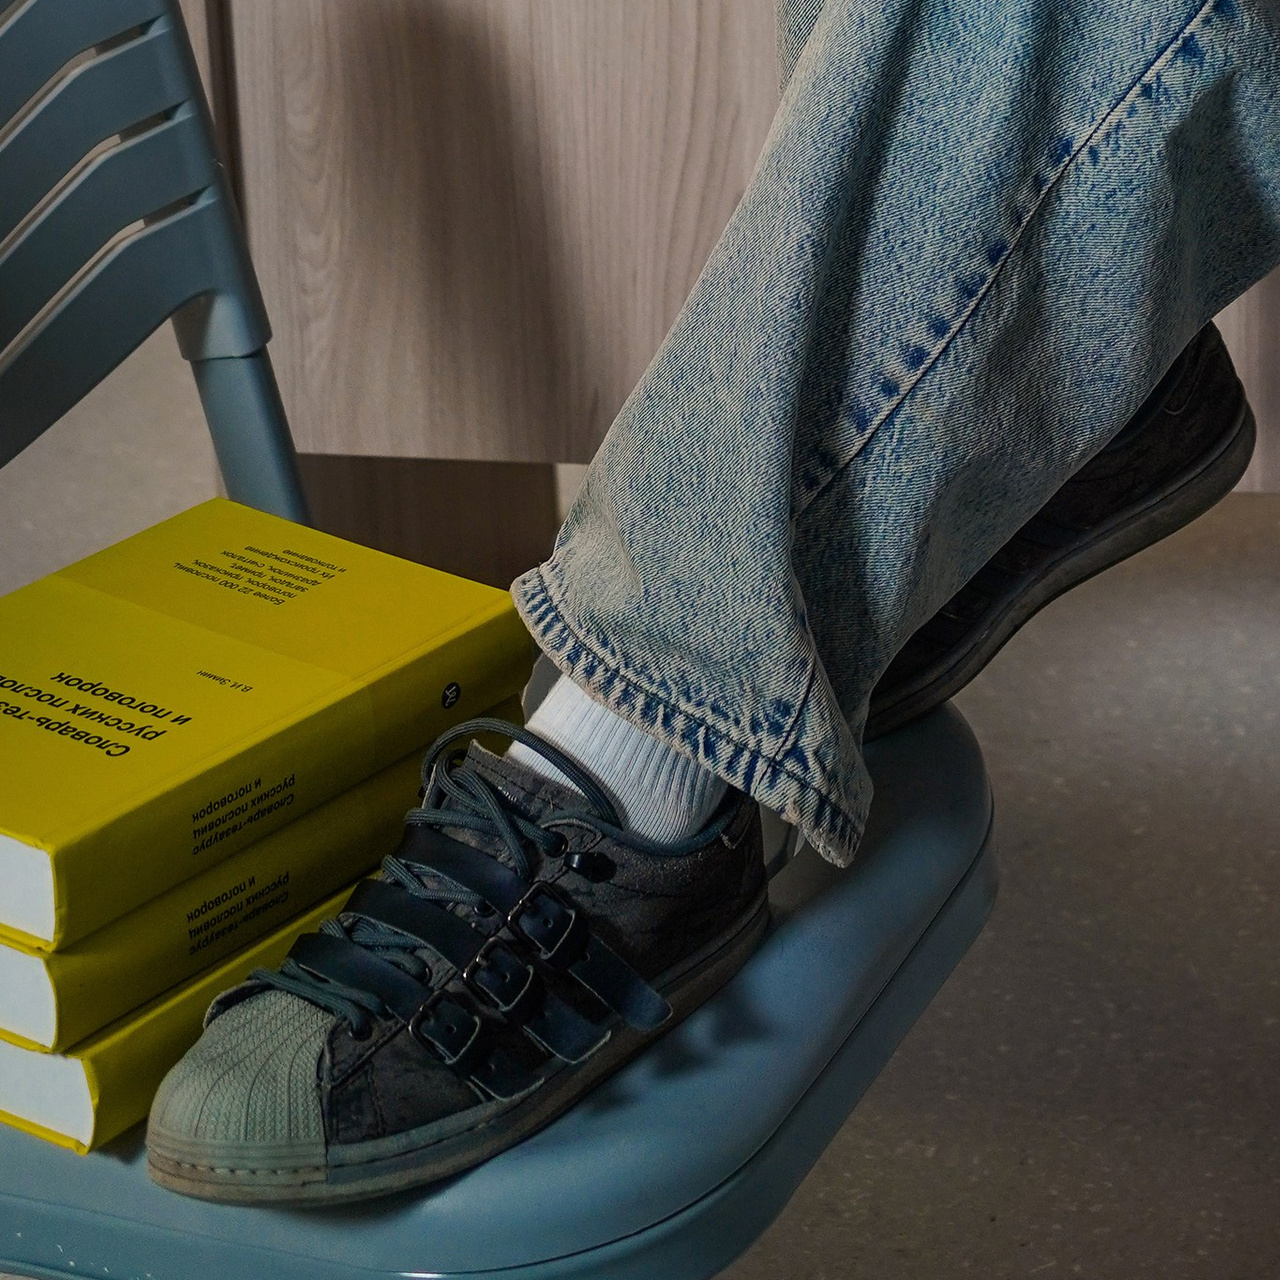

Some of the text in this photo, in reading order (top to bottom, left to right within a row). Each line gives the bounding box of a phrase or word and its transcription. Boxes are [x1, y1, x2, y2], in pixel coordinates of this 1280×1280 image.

[253, 592, 285, 605] Более
[50, 672, 192, 726] и поговорок
[66, 704, 167, 741] русских
[191, 776, 261, 823] и поговорок
[191, 772, 295, 839] русских пословиц
[186, 880, 246, 923] поговорок
